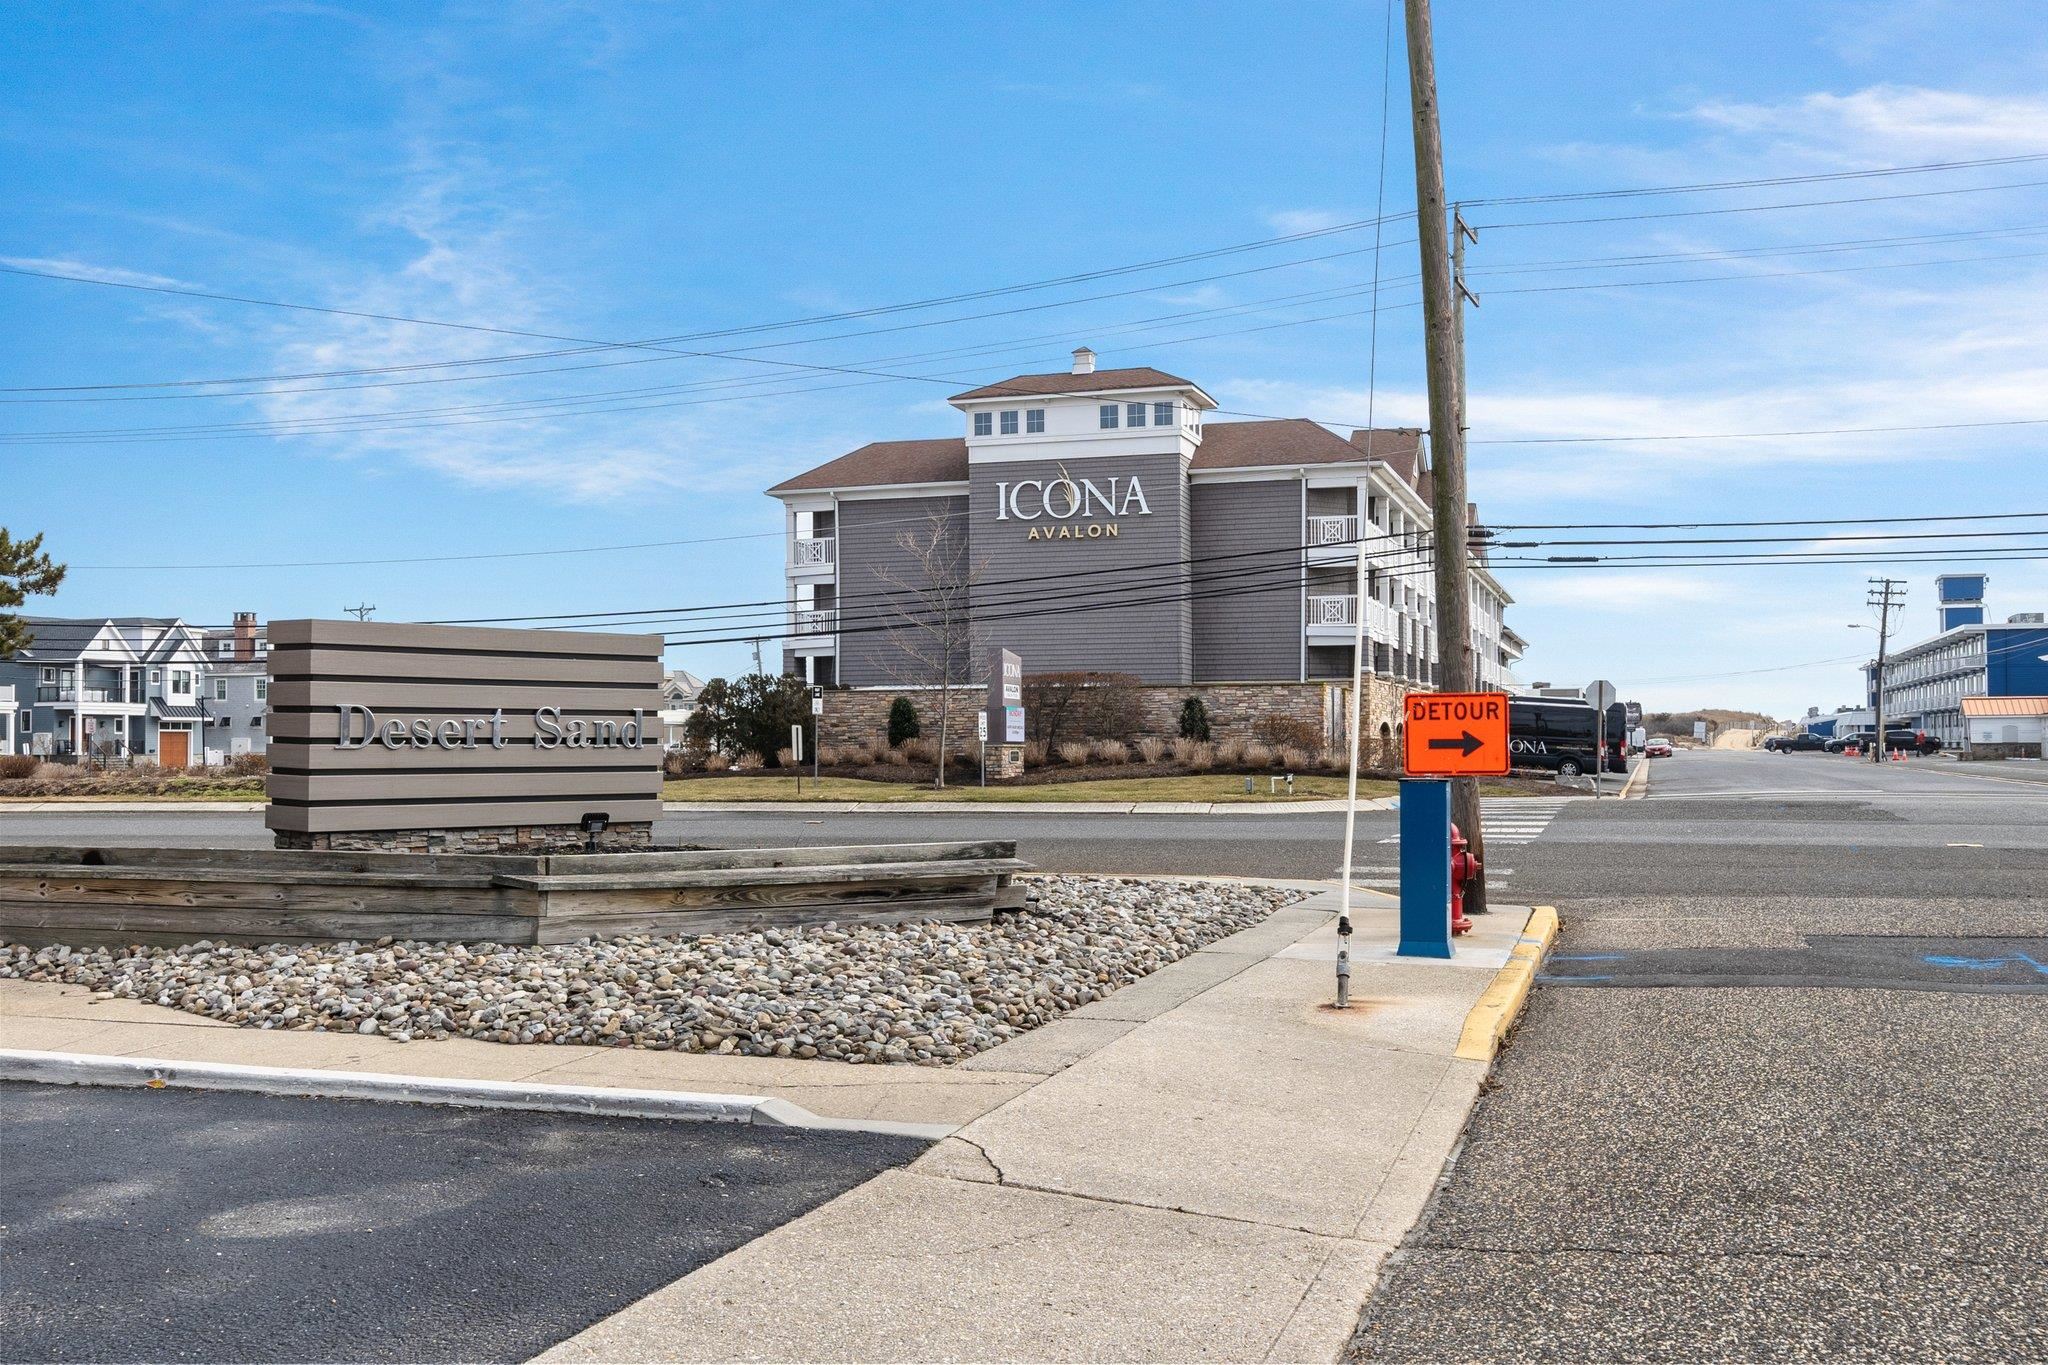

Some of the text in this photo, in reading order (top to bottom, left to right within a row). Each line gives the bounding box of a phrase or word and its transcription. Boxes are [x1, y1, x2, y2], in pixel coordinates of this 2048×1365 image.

[996, 476, 1152, 520] ICONA
[1027, 523, 1118, 540] AVALON
[1413, 702, 1499, 720] DETOUR
[334, 703, 644, 750] Desert Sand
[1510, 740, 1547, 754] ONA
